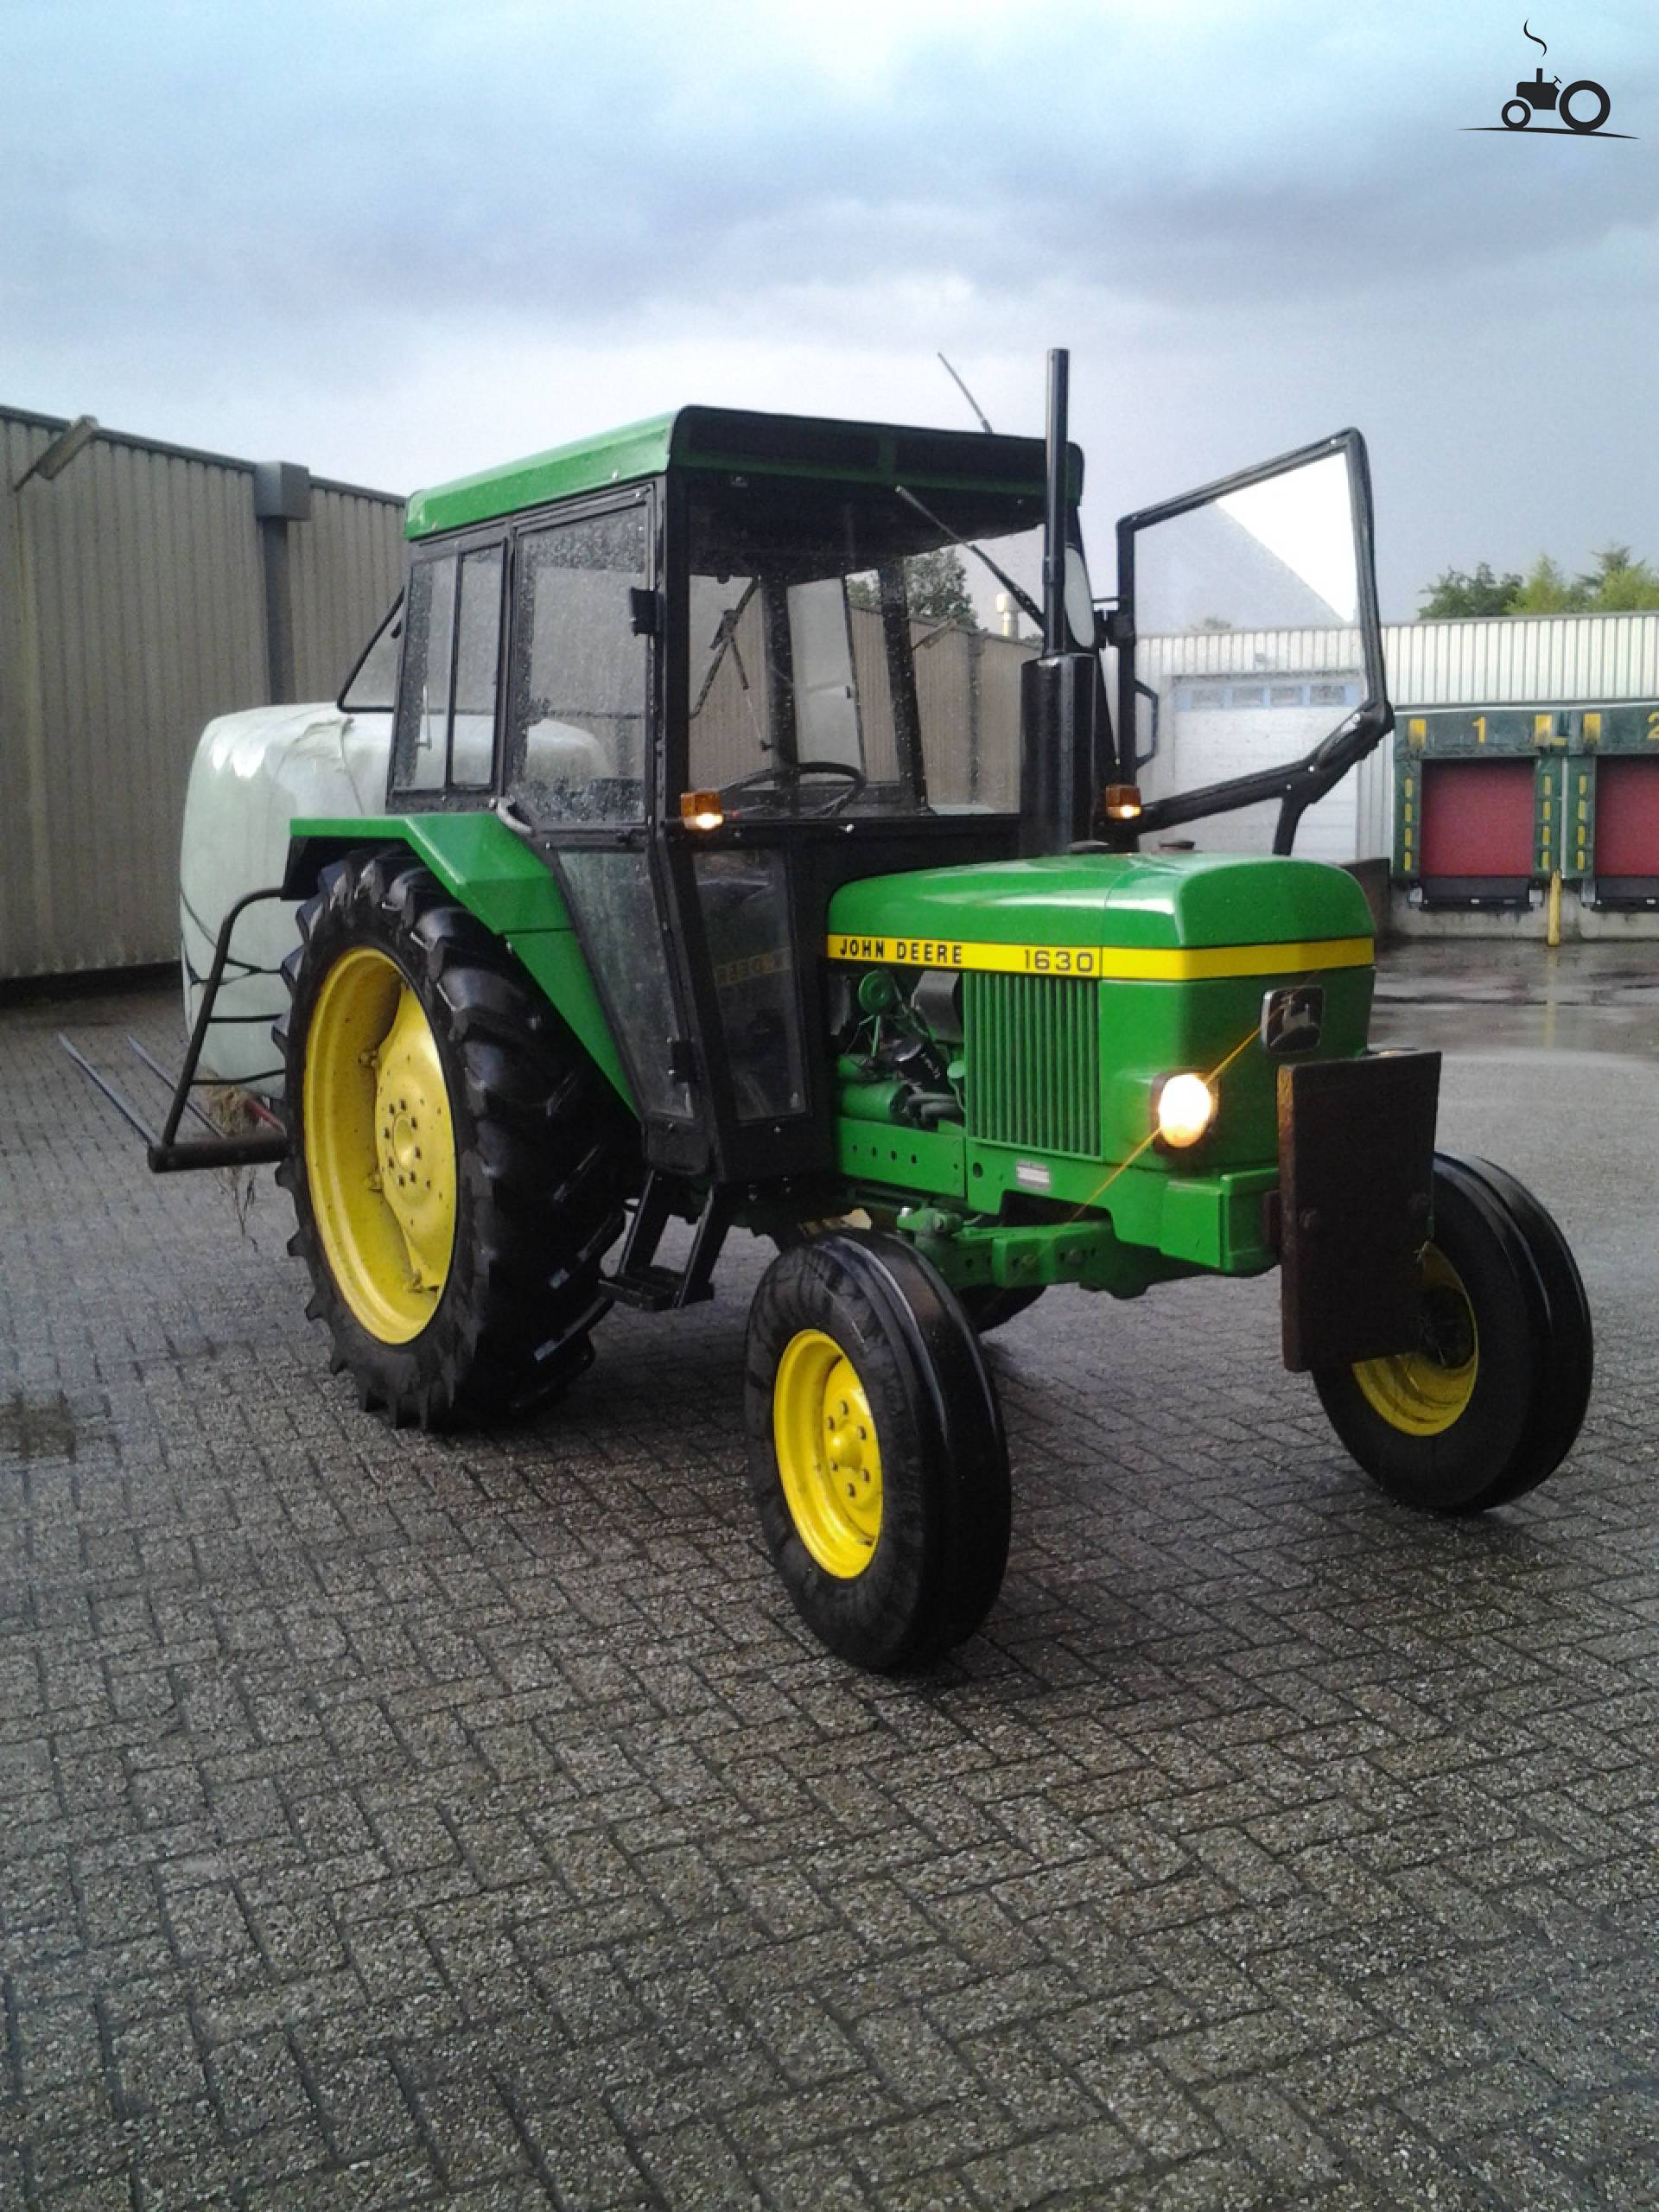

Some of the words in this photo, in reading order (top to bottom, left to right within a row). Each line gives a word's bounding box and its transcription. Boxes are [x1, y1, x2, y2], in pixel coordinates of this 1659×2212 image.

[1472, 716, 1486, 743] 1
[839, 938, 886, 958] JOHN
[896, 941, 962, 964] DEERE
[1025, 949, 1094, 972] 1630
